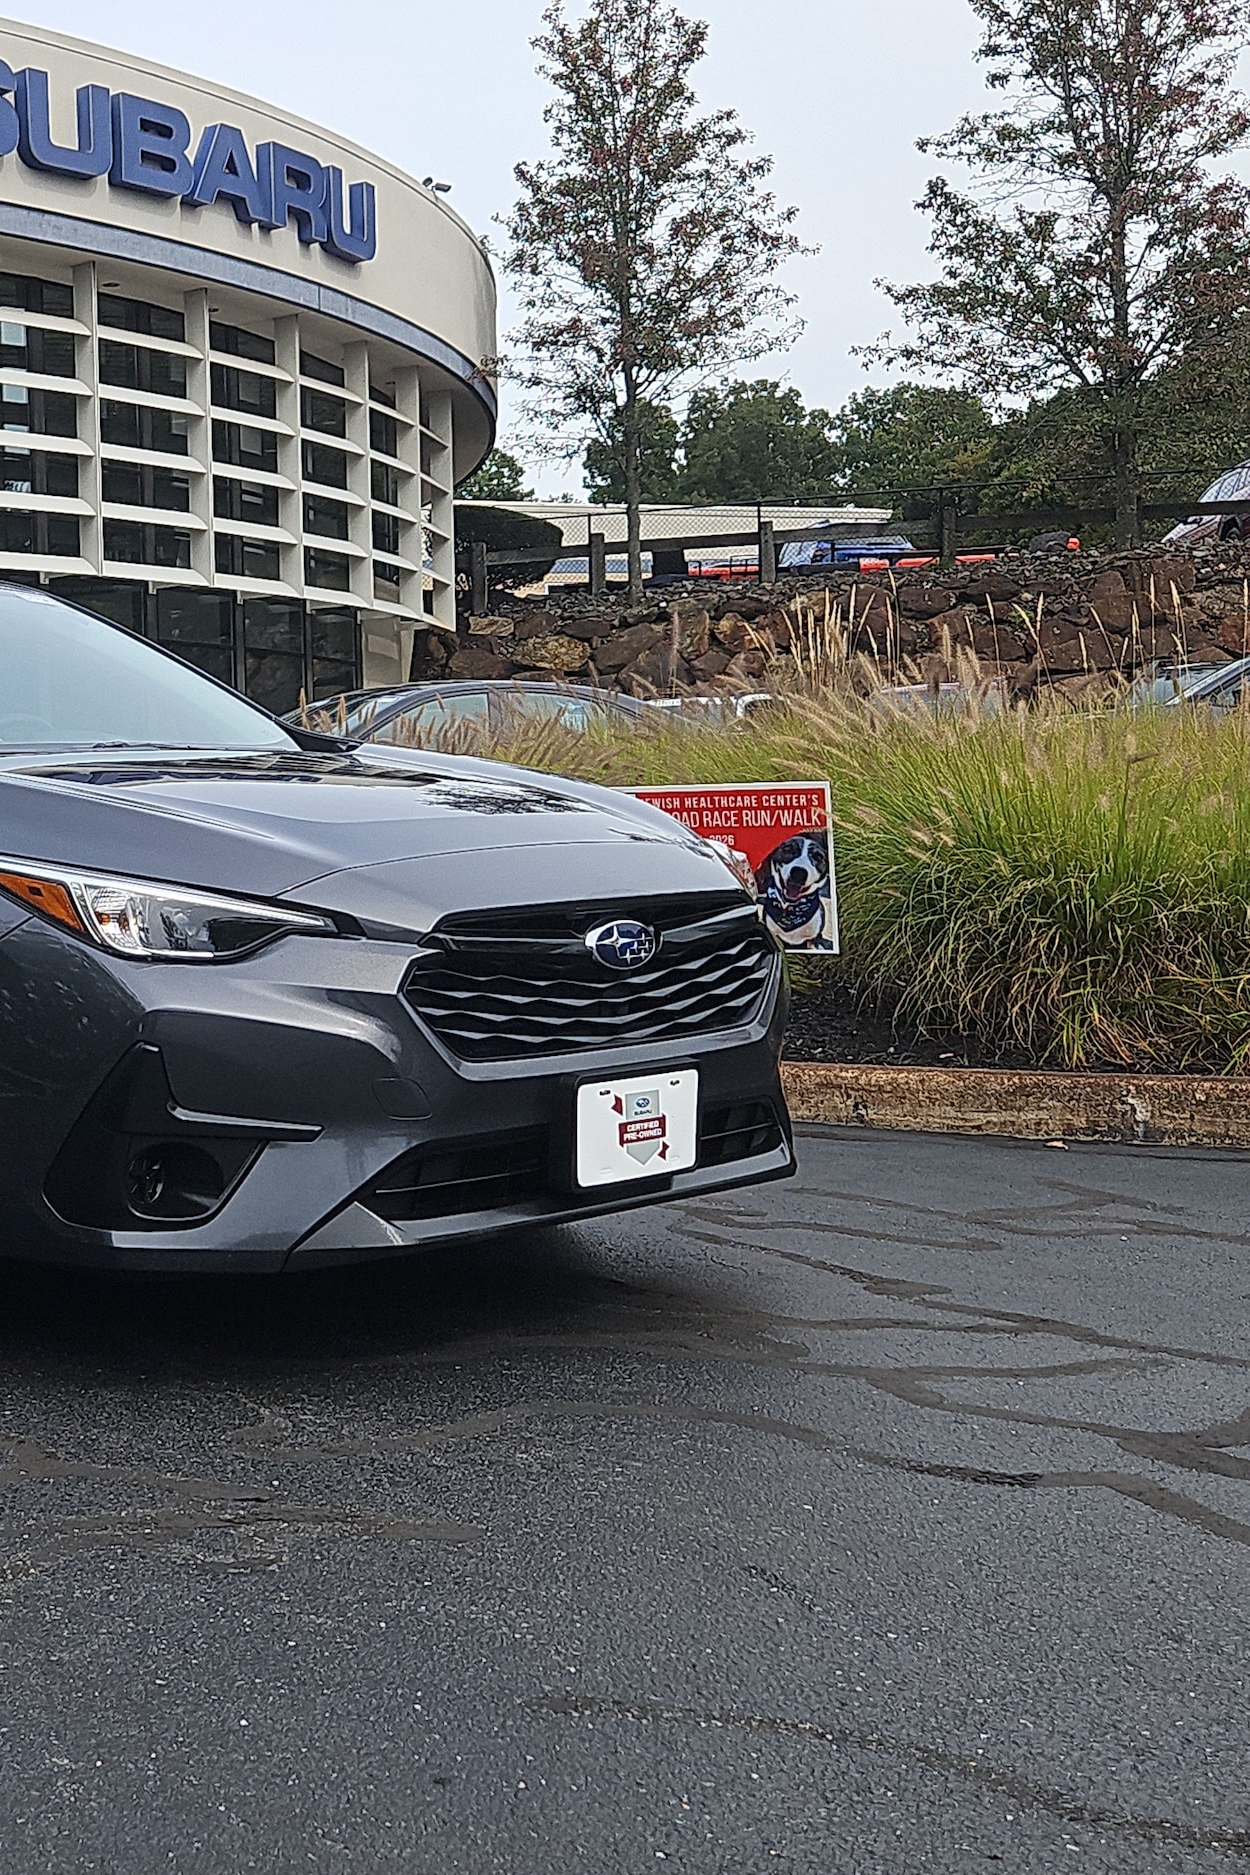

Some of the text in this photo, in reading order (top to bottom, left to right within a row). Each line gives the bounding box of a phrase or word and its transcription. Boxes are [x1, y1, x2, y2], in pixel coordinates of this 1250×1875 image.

[642, 793, 819, 810] EWISH HEALTHCARE CENTER'S
[669, 807, 821, 828] AD RACE RUN/WALK
[627, 1120, 659, 1131] CERTIFIED
[623, 1128, 662, 1141] PRE-OWNED
